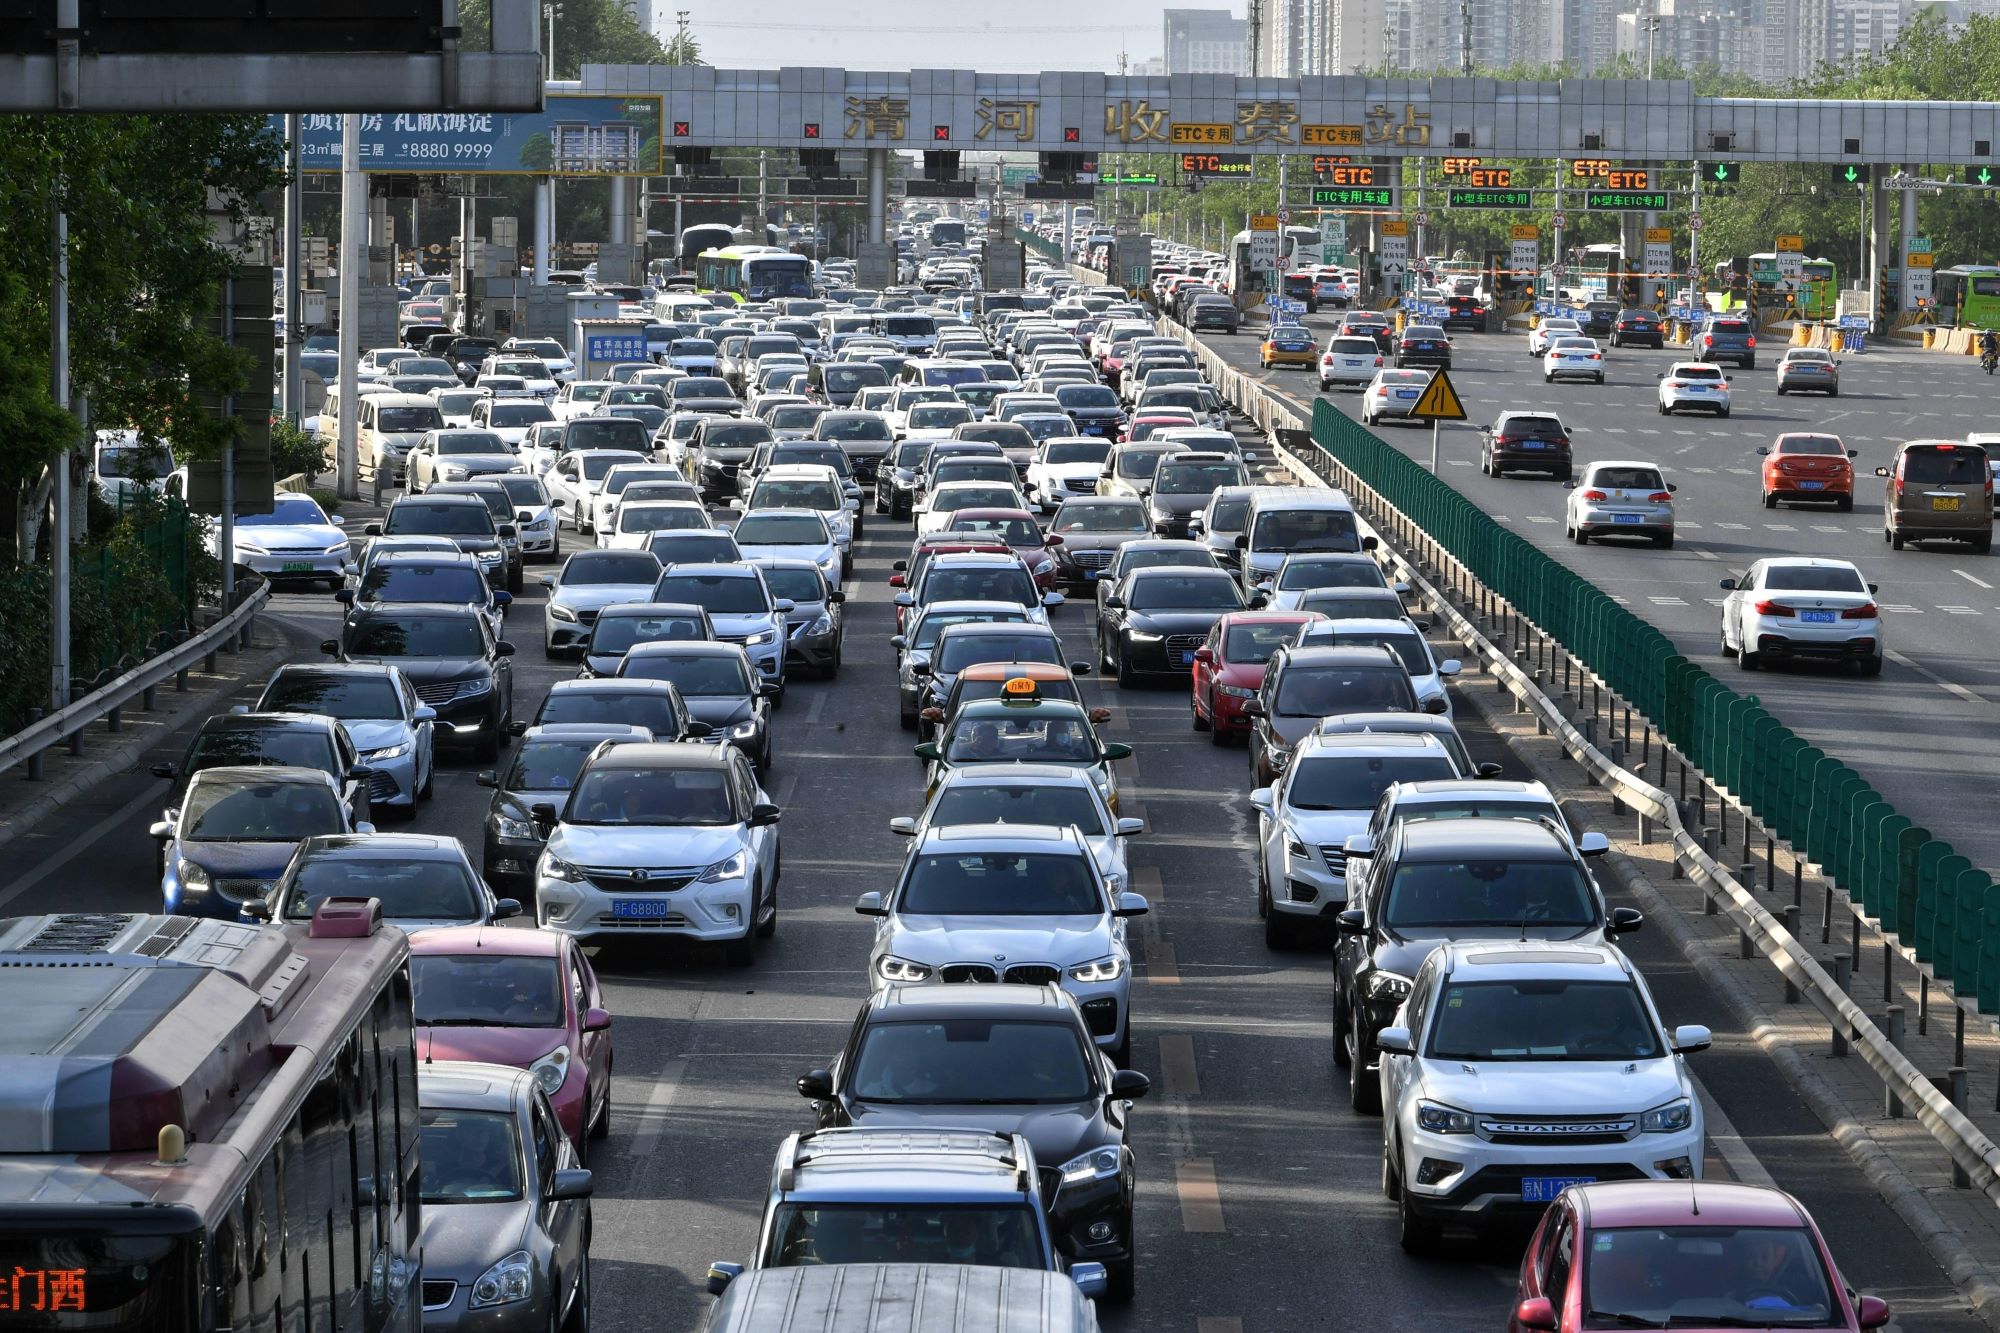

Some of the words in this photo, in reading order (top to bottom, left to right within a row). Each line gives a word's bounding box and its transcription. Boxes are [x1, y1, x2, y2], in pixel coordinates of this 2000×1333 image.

[844, 96, 1431, 146] 清河收费站
[1173, 127, 1230, 141] ETC专用
[1304, 128, 1361, 143] ETC专用
[410, 143, 449, 158] 8880
[454, 143, 493, 158] 9999
[1183, 156, 1219, 171] ETC
[1574, 160, 1609, 176] ETC
[1334, 168, 1372, 185] ETC
[1472, 170, 1510, 187] ETC
[1609, 172, 1647, 189] ETC
[1316, 190, 1390, 204] ETC专用车道
[1453, 193, 1527, 205] 小型车ETC专用
[1590, 195, 1664, 207] 小型车ETC专用
[1254, 218, 1265, 227] 20
[1384, 224, 1394, 232] 20
[1514, 227, 1524, 236] 20
[1648, 231, 1658, 239] 20
[1496, 1123, 1620, 1133] CHANGAN
[0, 1266, 87, 1311] 门西
